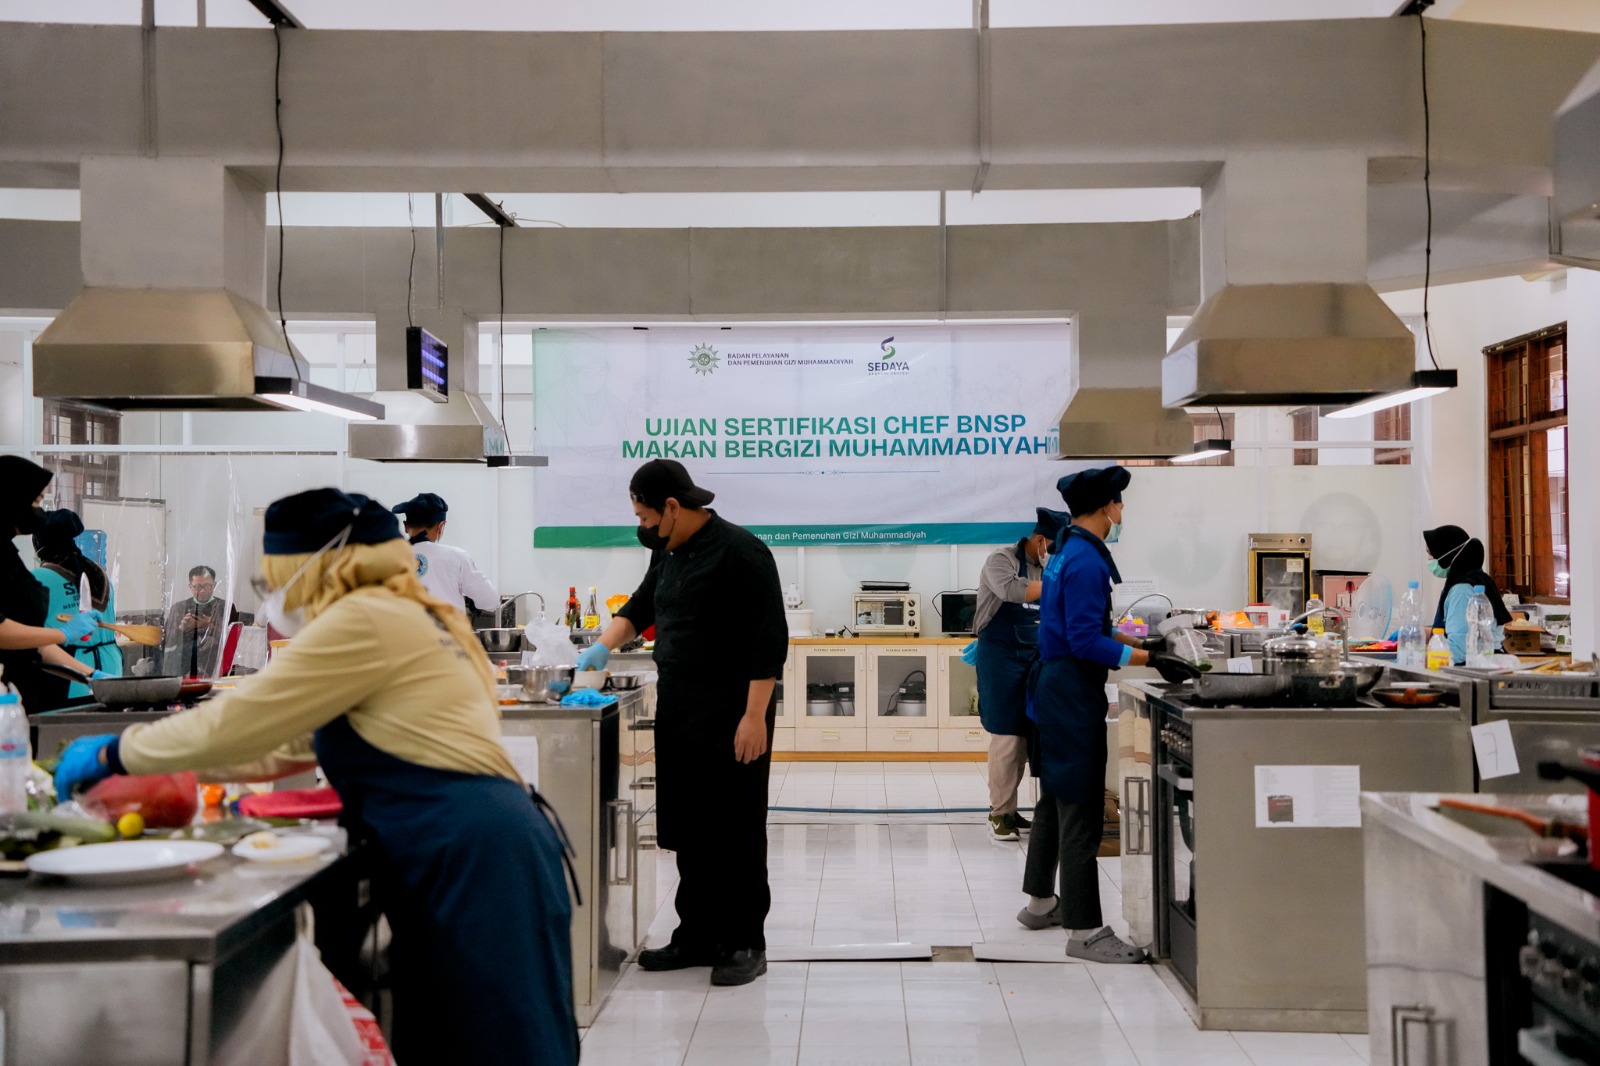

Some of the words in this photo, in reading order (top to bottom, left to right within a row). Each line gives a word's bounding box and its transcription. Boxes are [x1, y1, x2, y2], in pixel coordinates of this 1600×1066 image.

[798, 358, 854, 366] MUHAMMADIYAH
[867, 361, 910, 372] SEDAYA
[645, 417, 717, 437] UJIAN
[724, 416, 876, 437] SERTIFIKASI
[883, 415, 950, 434] CHEF
[957, 414, 1027, 433] BNSP
[622, 439, 717, 459] MAKAN
[724, 438, 821, 458] BERGIZI
[829, 436, 1048, 457] MUHAMMADIYAH
[774, 532, 791, 541] dan
[792, 532, 841, 541] Pemenuhan
[842, 531, 859, 540] Gizi
[861, 531, 927, 542] Muhammadiyah
